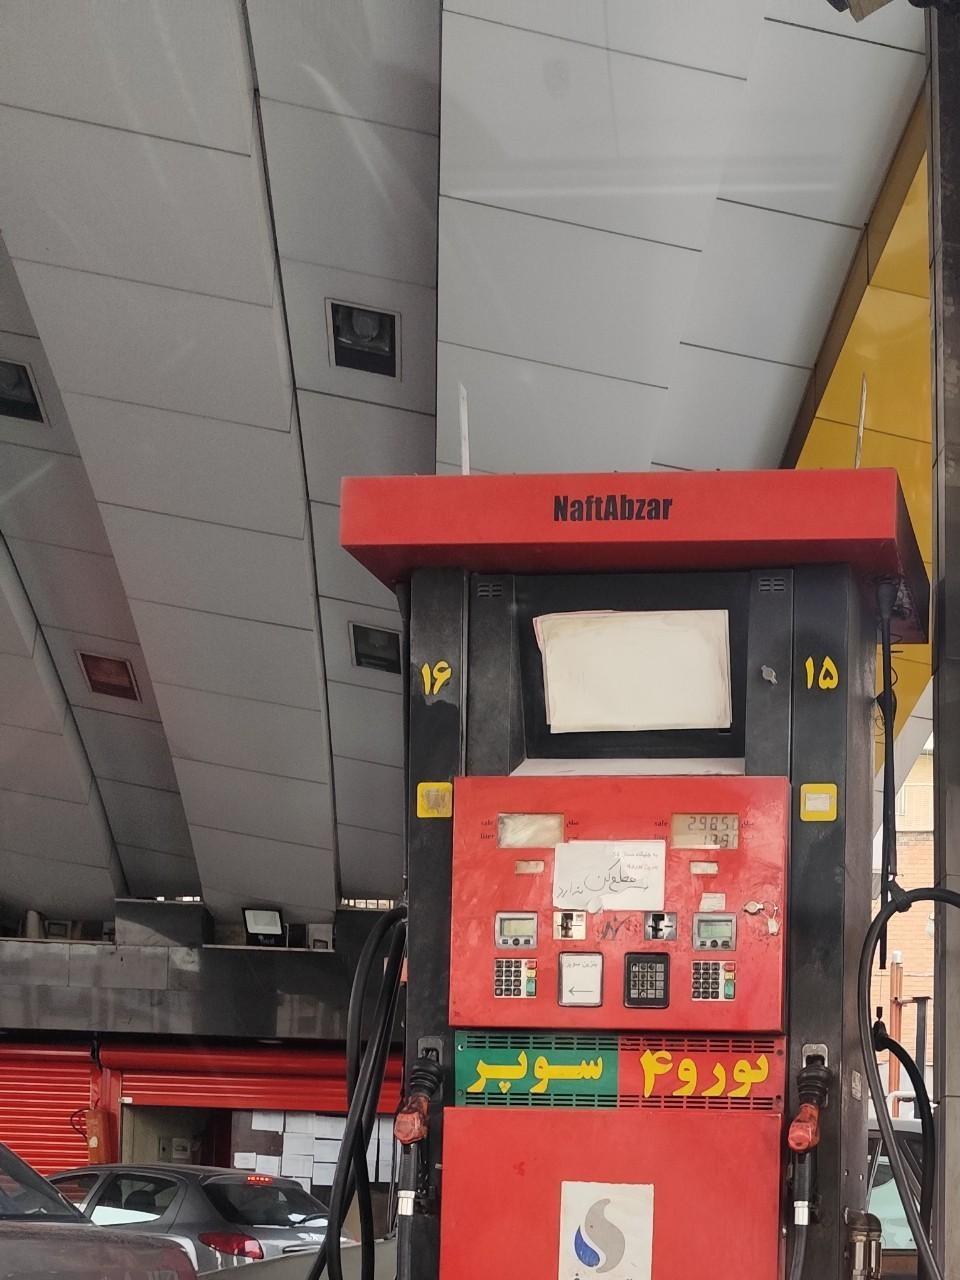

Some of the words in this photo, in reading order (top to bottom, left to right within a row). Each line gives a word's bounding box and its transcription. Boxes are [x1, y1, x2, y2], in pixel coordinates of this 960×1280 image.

[554, 494, 672, 521] NaftAbzar
[421, 661, 452, 695] ۱۶
[805, 657, 839, 689] ۱۵
[467, 1051, 603, 1094] سوپر
